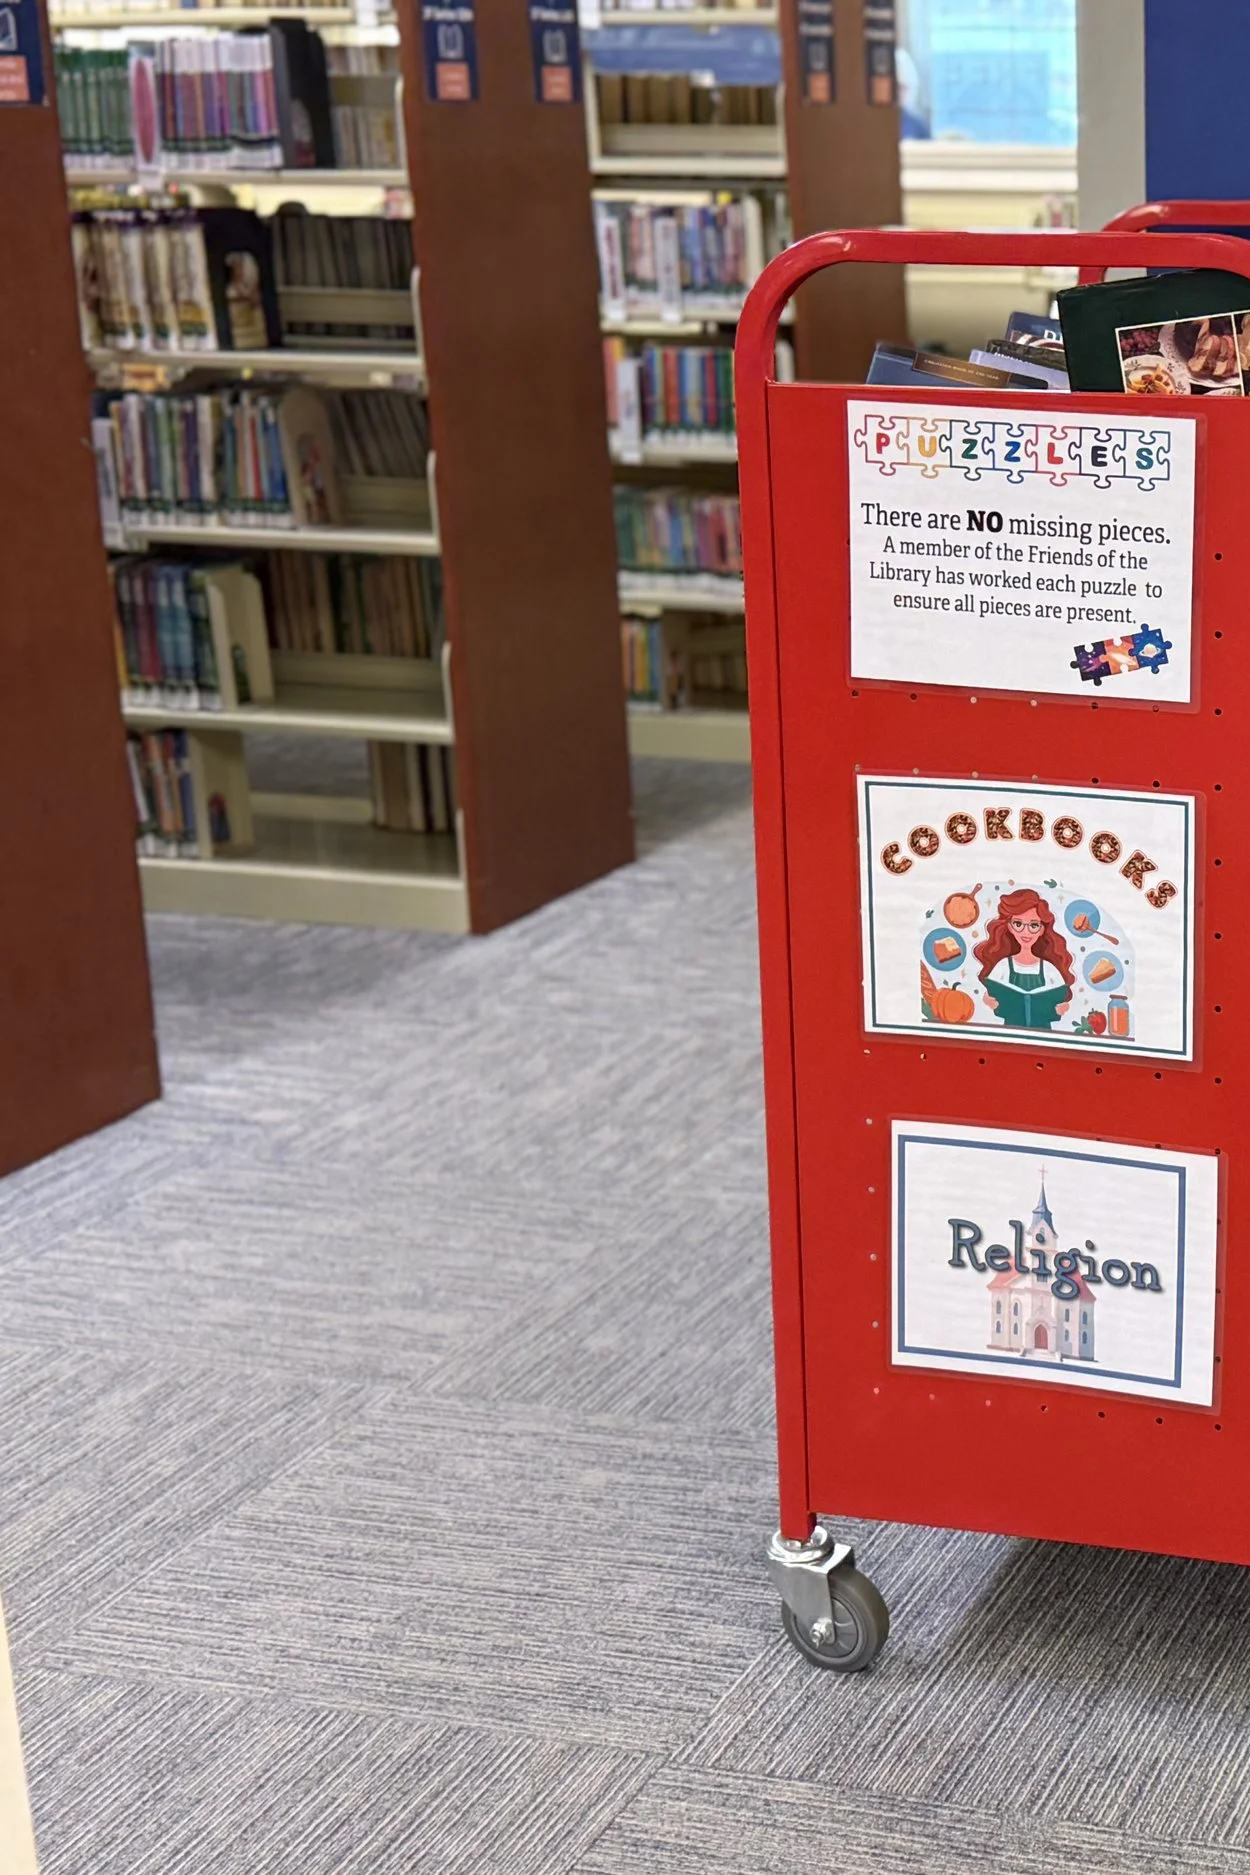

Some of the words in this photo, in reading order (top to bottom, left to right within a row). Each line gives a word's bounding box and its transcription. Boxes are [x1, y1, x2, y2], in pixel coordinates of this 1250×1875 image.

[875, 432, 1155, 469] PUZZLES
[861, 503, 922, 529] There
[928, 510, 961, 531] are
[966, 509, 1003, 533] NO
[1009, 514, 1092, 545] missing
[1098, 518, 1171, 546] pieces.
[883, 537, 896, 554] A
[900, 537, 971, 559] member
[975, 541, 993, 561] of
[996, 543, 1024, 562] the
[1028, 545, 1092, 567] Friends
[1097, 547, 1116, 569] of
[1120, 550, 1148, 570] the
[869, 561, 931, 587] Library
[935, 565, 964, 585] has
[969, 567, 1032, 590] worked
[1036, 571, 1076, 594] each
[1080, 573, 1137, 598] puzzle
[1145, 578, 1163, 598] to
[893, 595, 951, 612] ensure
[954, 593, 975, 612] all
[979, 597, 1031, 618] pieces
[1035, 603, 1062, 619] are
[1066, 602, 1137, 624] present.
[880, 806, 1178, 910] COOKBOOKS
[947, 1218, 1164, 1300] Religion
